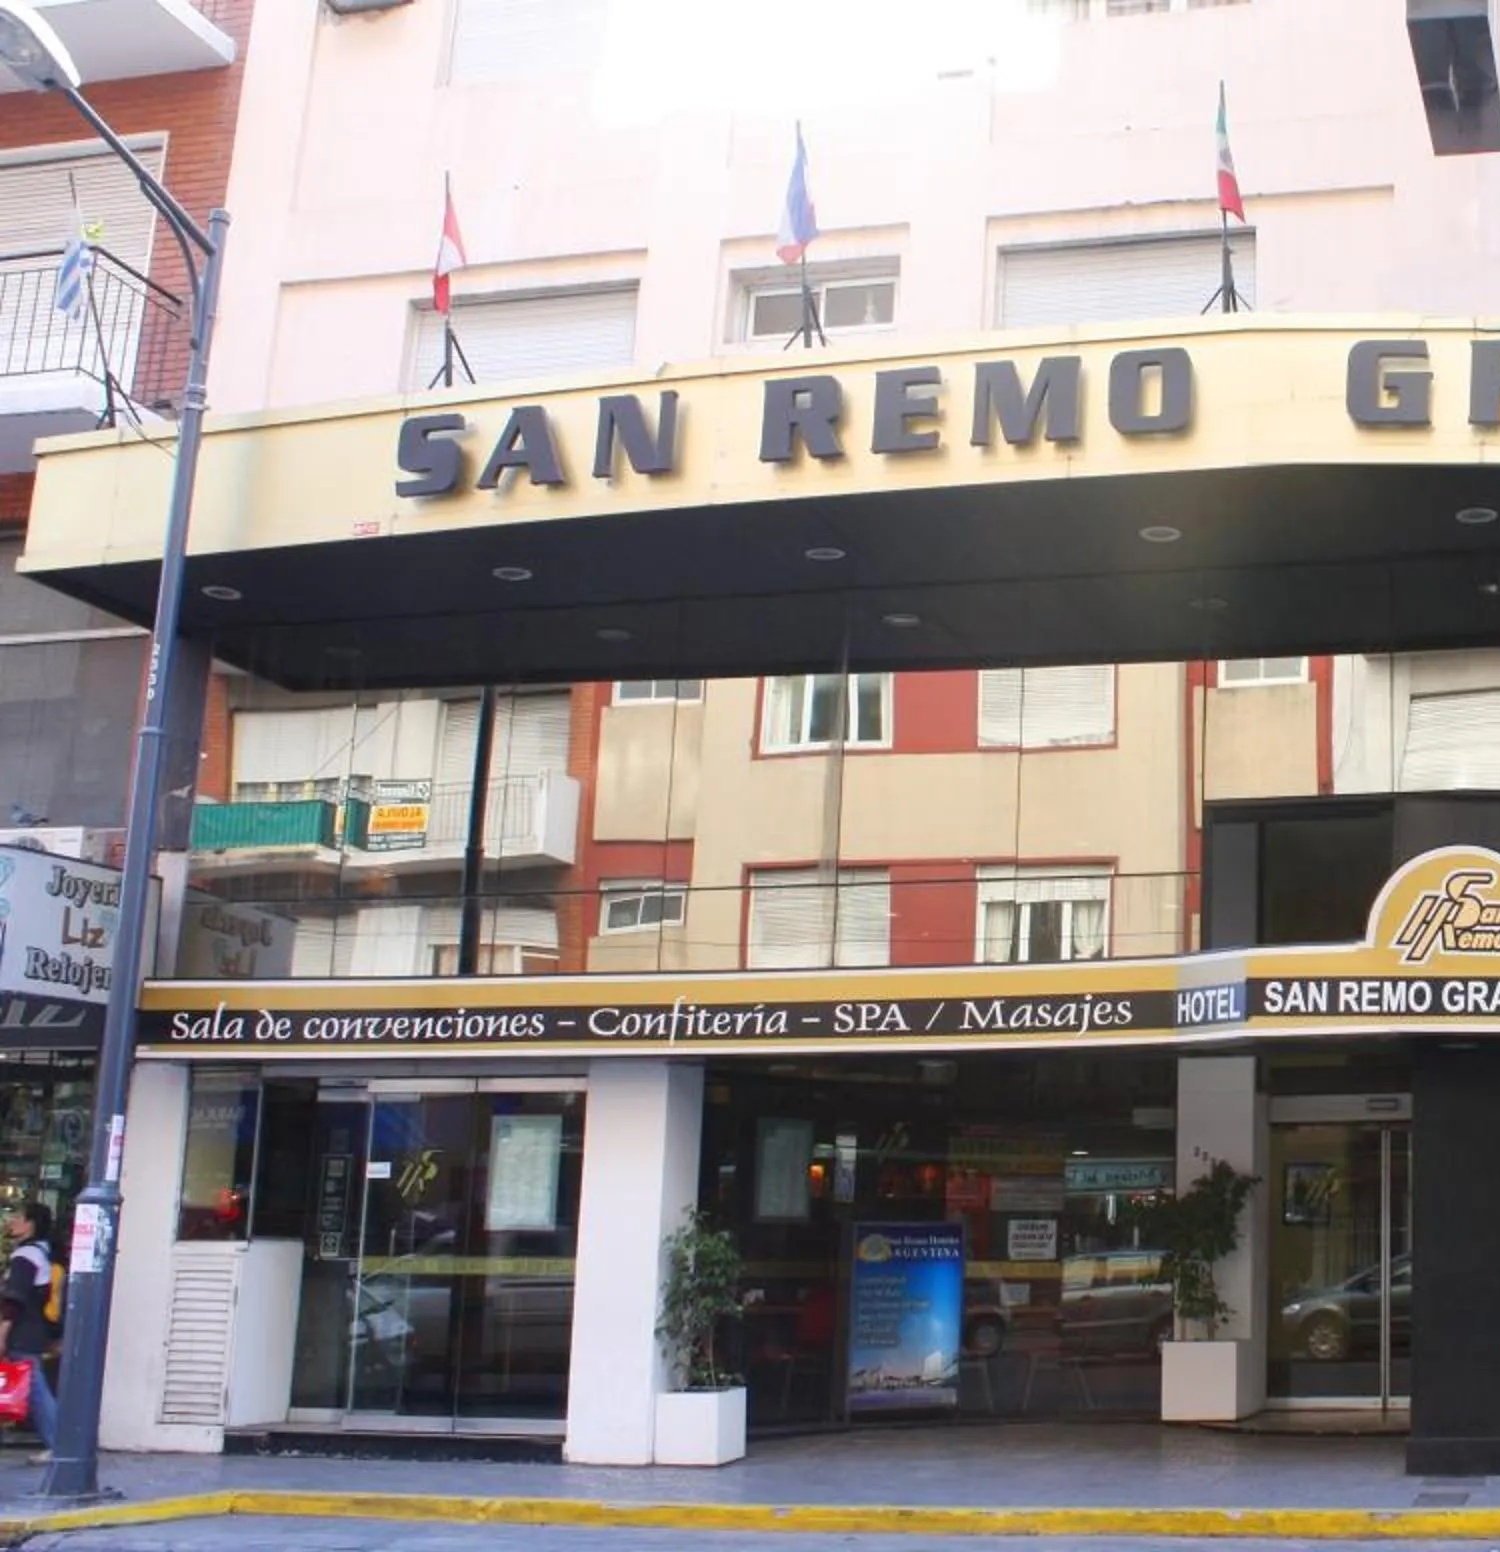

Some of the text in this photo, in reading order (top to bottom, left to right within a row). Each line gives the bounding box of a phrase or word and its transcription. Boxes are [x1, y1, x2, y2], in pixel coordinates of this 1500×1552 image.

[395, 390, 680, 498] SAN
[759, 346, 1195, 463] REMO
[170, 1001, 244, 1040] Sala
[255, 1007, 291, 1040] de
[302, 1007, 545, 1040] convenciones
[587, 995, 789, 1046] Confitería
[833, 1001, 911, 1033] SPA
[960, 993, 1133, 1035] Masajes
[1177, 985, 1241, 1024] HOTEL
[1264, 981, 1328, 1014] SAN
[1338, 981, 1432, 1014] REMO
